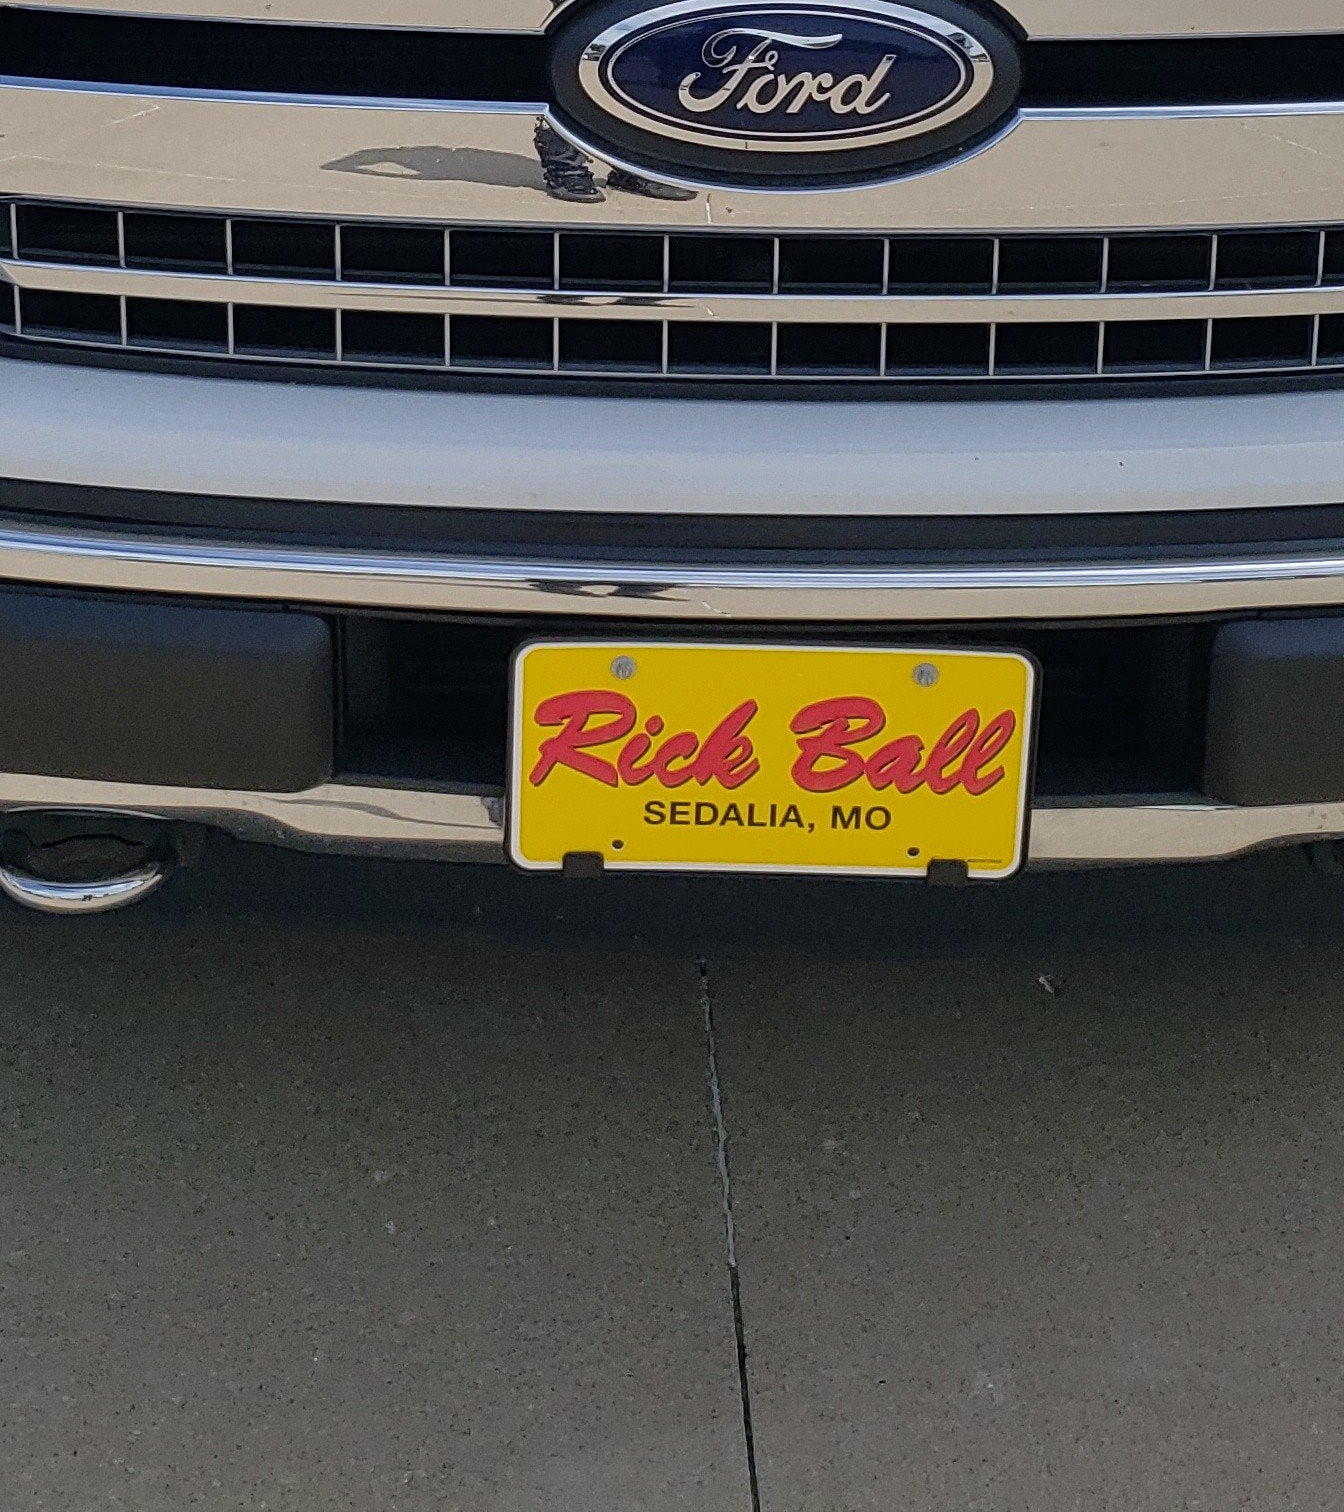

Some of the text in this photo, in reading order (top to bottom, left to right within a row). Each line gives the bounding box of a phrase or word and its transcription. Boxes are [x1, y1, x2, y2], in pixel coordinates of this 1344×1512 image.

[677, 27, 898, 115] Ford
[529, 689, 1017, 795] Rick Ball
[642, 800, 893, 834] SEDALIA, MO
